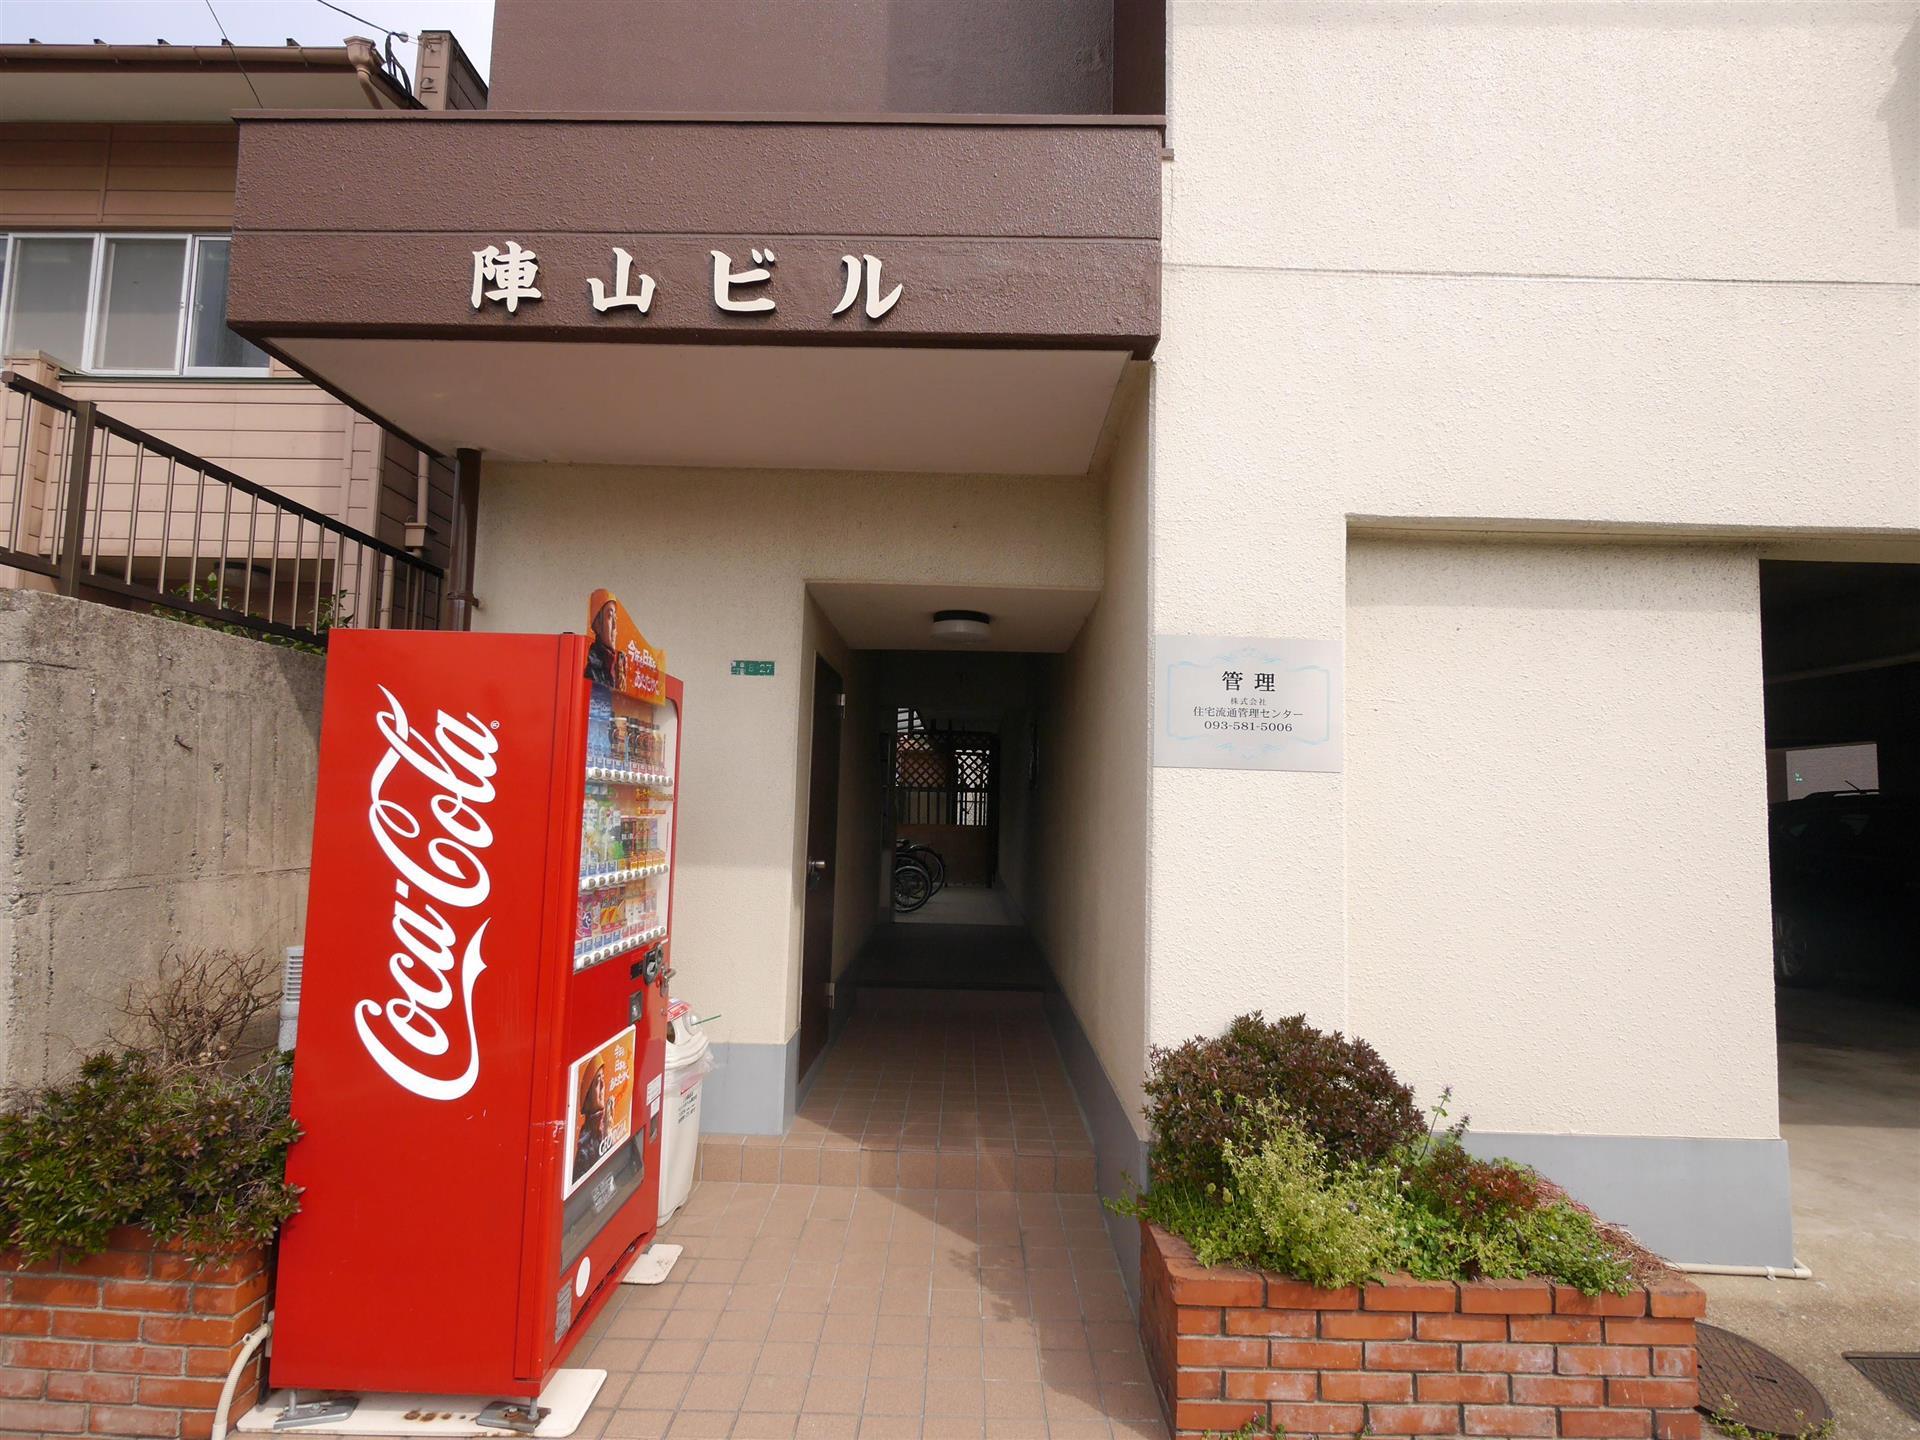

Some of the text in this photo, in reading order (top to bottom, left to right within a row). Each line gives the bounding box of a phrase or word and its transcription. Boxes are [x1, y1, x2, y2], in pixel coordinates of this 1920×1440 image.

[470, 240, 904, 319] 陣山ビル
[1221, 671, 1276, 692] 管理
[1230, 697, 1267, 706] 株式会社
[1193, 706, 1304, 719] 住宅流通管理センター
[1204, 720, 1293, 732] 093-581-5006
[354, 683, 499, 1101] Coca-Cola
